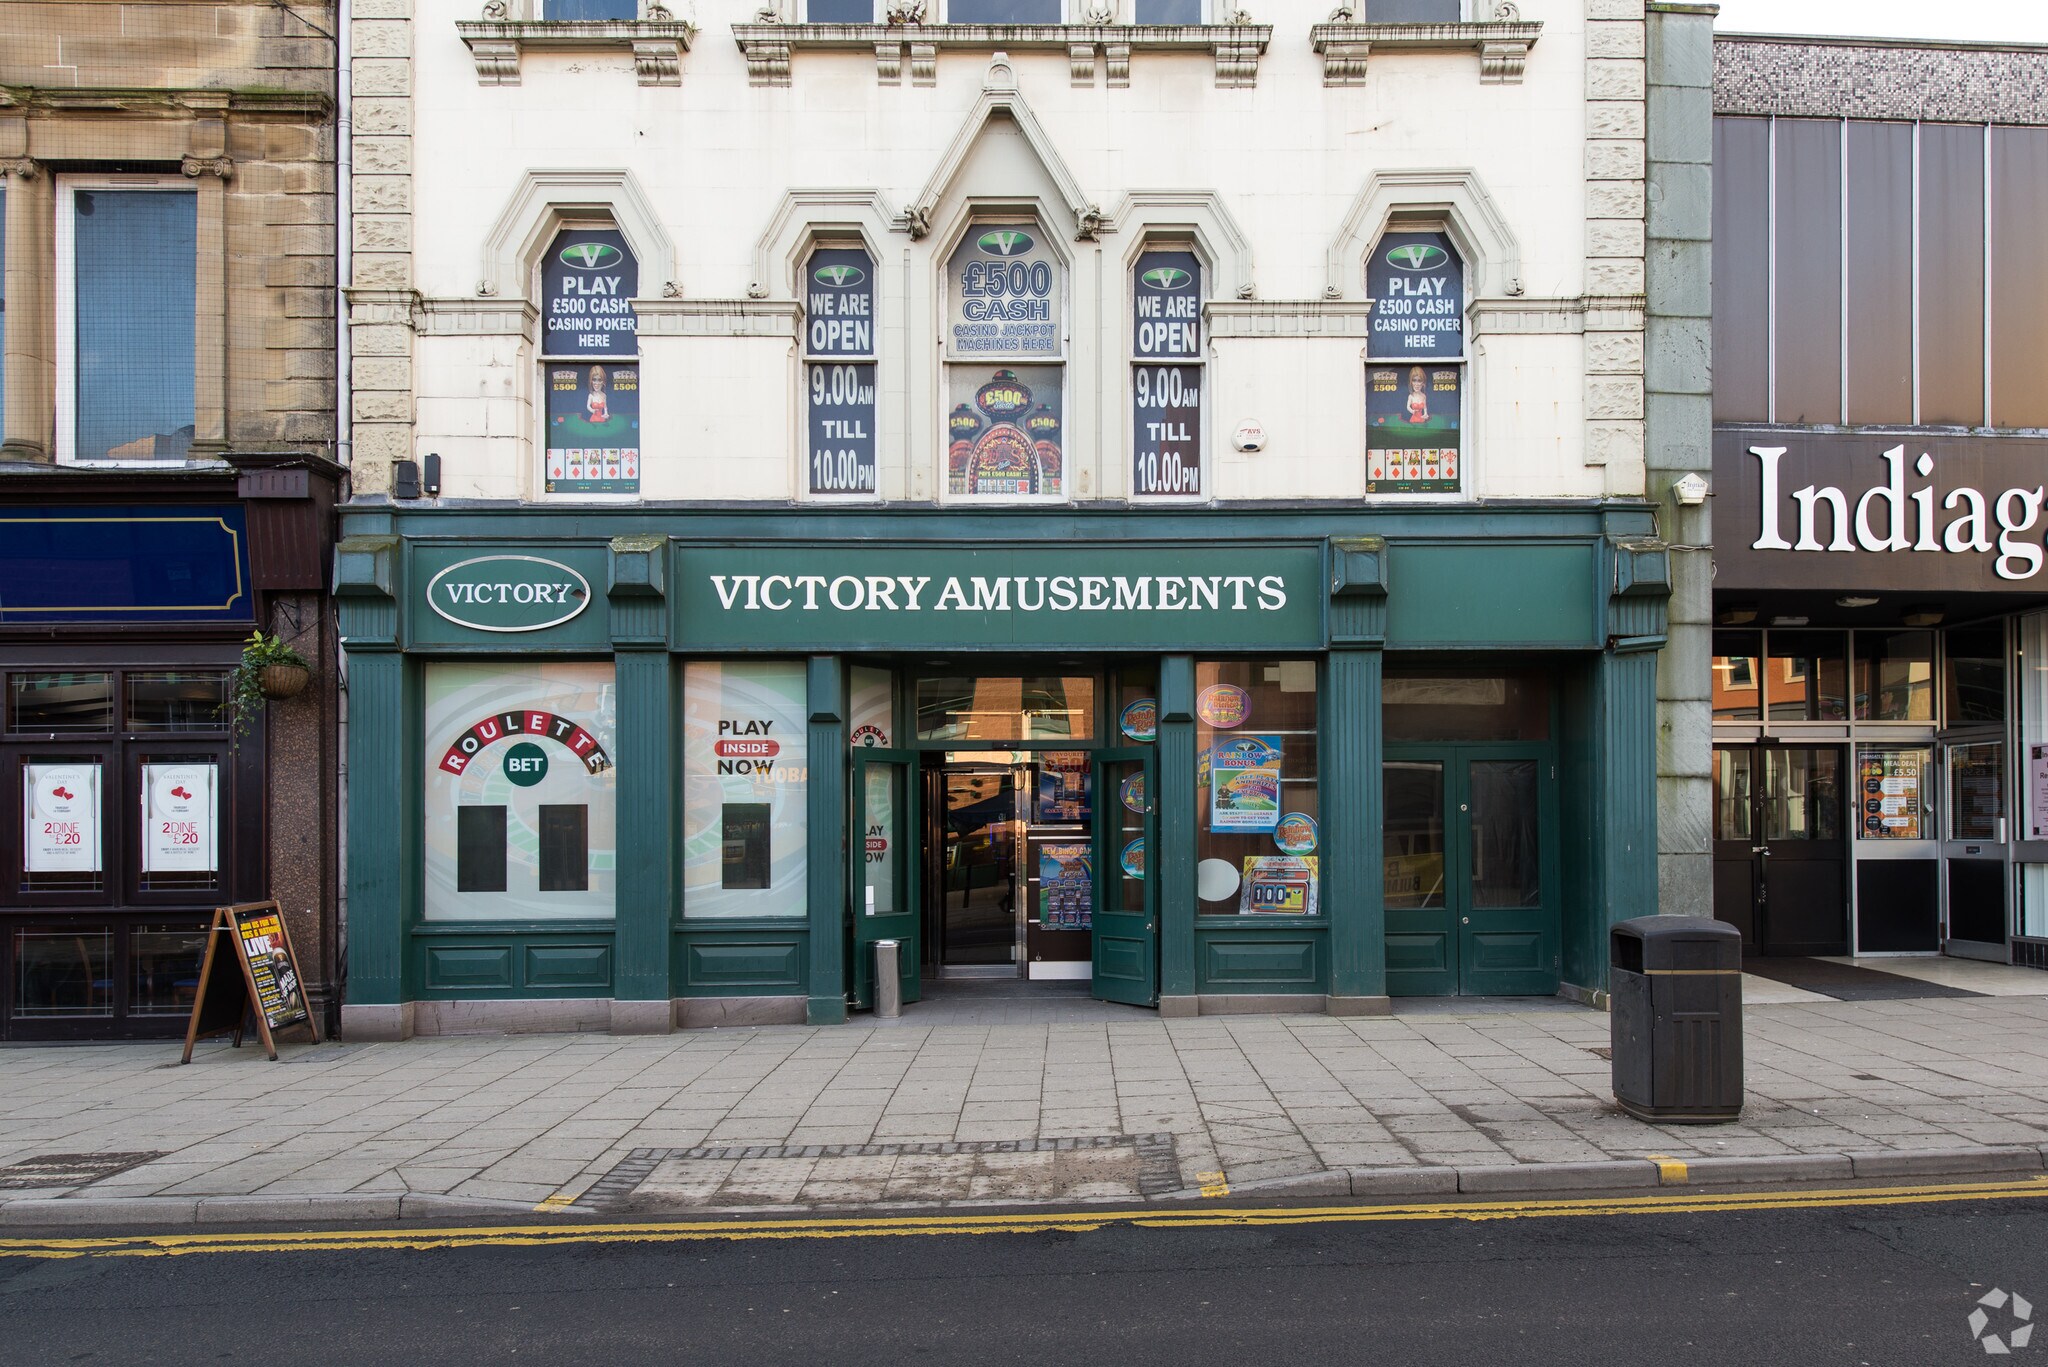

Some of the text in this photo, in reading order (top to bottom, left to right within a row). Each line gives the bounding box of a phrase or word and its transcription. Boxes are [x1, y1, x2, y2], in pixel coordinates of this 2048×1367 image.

[994, 232, 1017, 255] V
[578, 246, 603, 268] V
[1405, 246, 1429, 269] V
[830, 268, 849, 285] V
[962, 260, 1052, 298] £500
[1157, 270, 1176, 288] V
[562, 276, 621, 295] PLAY
[1389, 278, 1447, 296] PLAY
[552, 298, 629, 314] £500 CASH
[810, 294, 869, 315] WE ARE
[963, 299, 1050, 321] CASH
[1138, 296, 1196, 318] WE ARE
[1379, 299, 1454, 315] £500 CASH
[548, 318, 636, 331] CASINO POKER
[954, 324, 1056, 337] CASINO JACKPOT
[1374, 318, 1460, 331] CASINO POKER
[578, 334, 610, 347] HERE
[812, 320, 870, 350] OPEN
[1138, 322, 1196, 353] OPEN
[1404, 335, 1436, 348] HERE
[956, 338, 1054, 351] MACHINES HERE
[1374, 384, 1397, 392] £500
[1433, 384, 1456, 392] £500
[986, 390, 1022, 406] £500
[822, 420, 867, 438] TILL
[950, 417, 975, 428] £500
[1030, 417, 1055, 428] £500
[1146, 422, 1192, 441] TILL
[1749, 444, 2048, 580] Indiag
[446, 583, 572, 603] VICTORY
[710, 575, 1287, 612] VICTORY AMUSEMENTS
[718, 720, 773, 735] PLAY
[447, 714, 604, 771] ROULETTE
[724, 744, 768, 753] INSIDE
[509, 758, 543, 772] BET
[718, 760, 774, 775] NOW
[56, 833, 80, 844] £20
[173, 833, 198, 844] £20
[866, 826, 884, 836] AY
[866, 853, 884, 862] OW
[243, 935, 273, 957] LIVE
[280, 969, 295, 990] MADE
